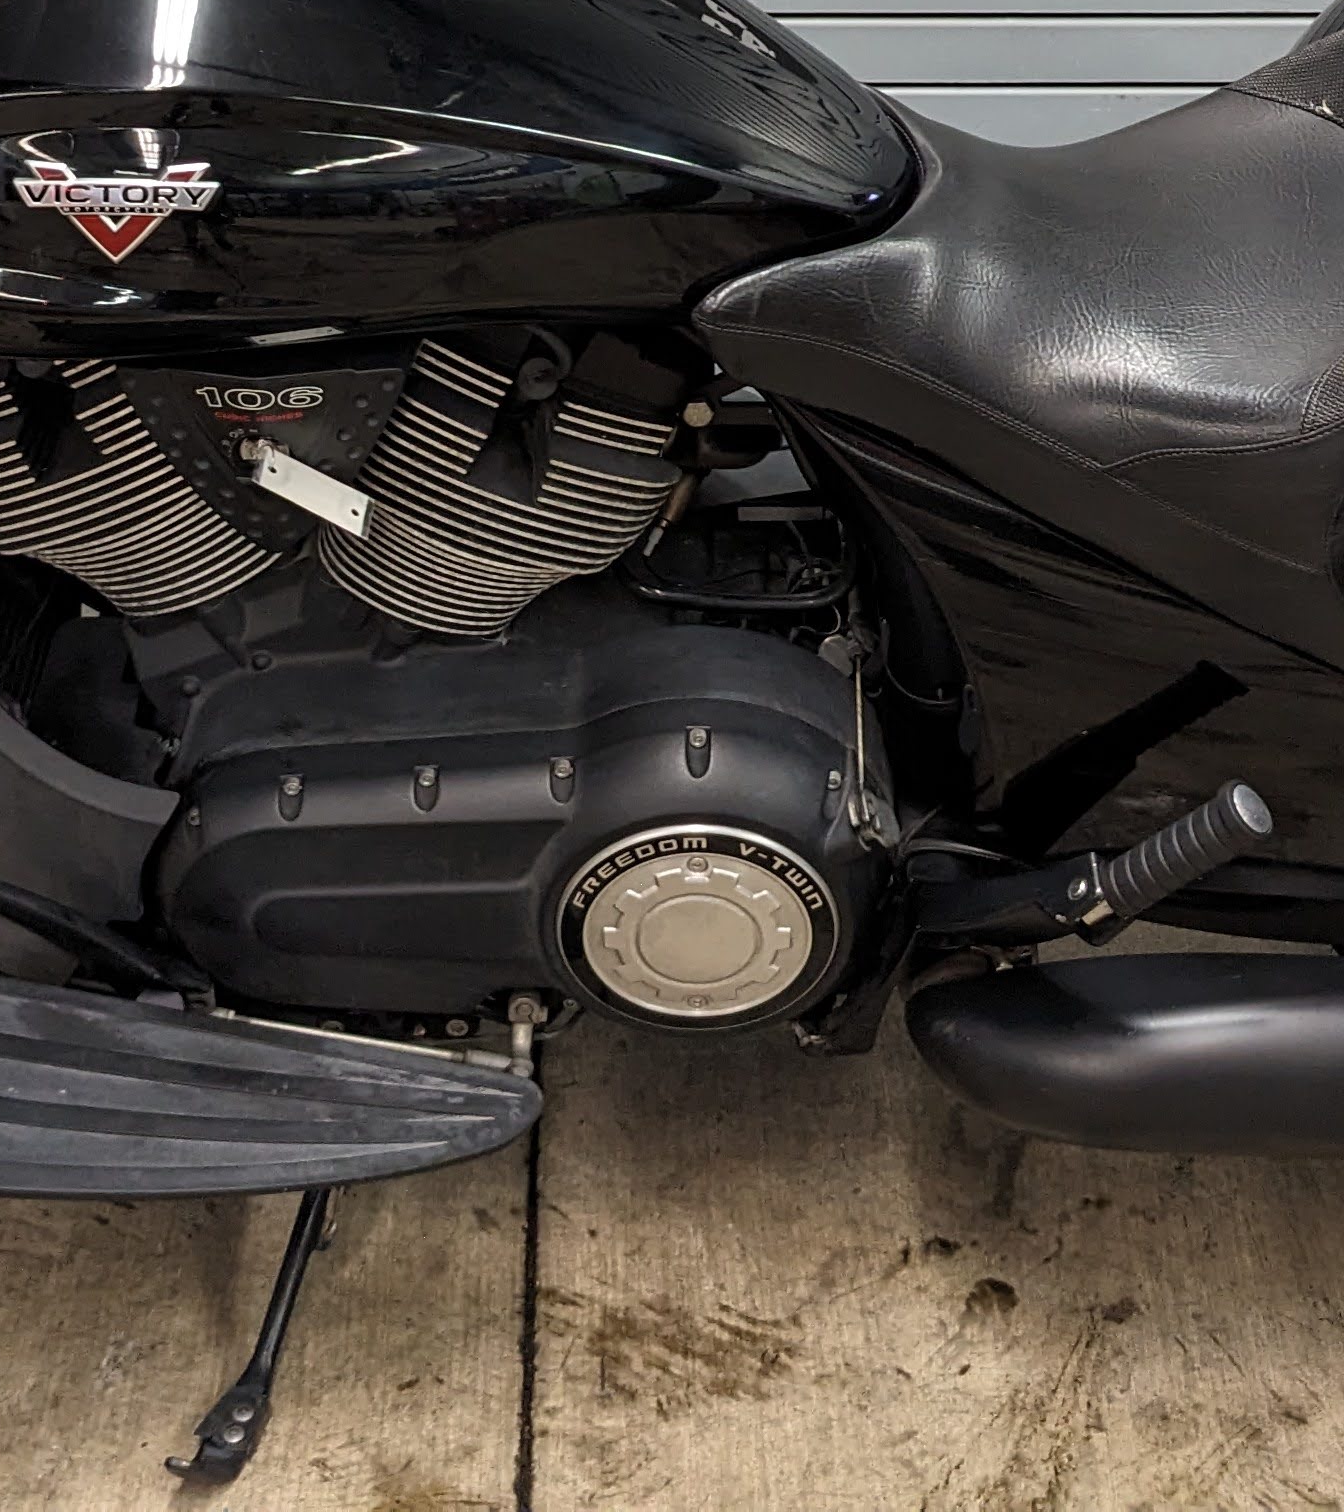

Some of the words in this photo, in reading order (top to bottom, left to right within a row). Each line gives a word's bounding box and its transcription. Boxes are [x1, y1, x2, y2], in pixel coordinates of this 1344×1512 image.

[23, 183, 208, 207] VICTORY
[196, 386, 324, 410] 106
[572, 837, 708, 910] FREEDOM
[739, 842, 825, 911] V-TWIN
